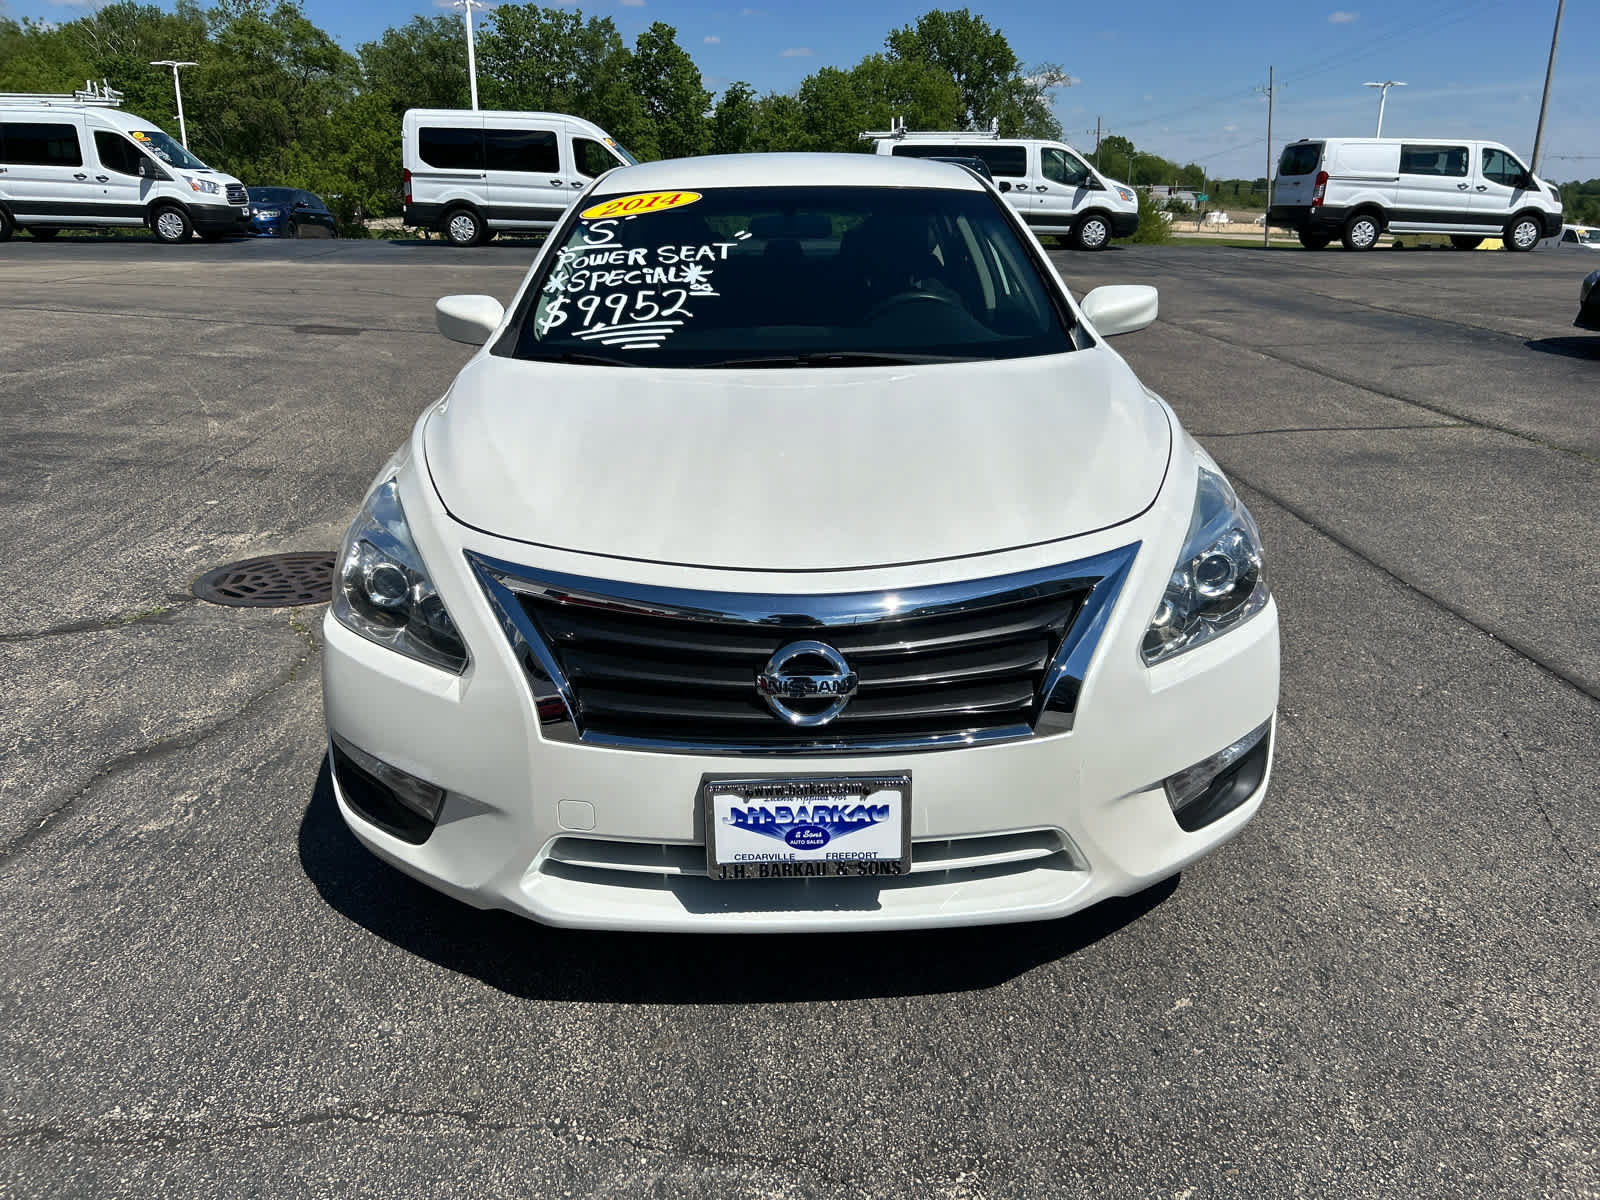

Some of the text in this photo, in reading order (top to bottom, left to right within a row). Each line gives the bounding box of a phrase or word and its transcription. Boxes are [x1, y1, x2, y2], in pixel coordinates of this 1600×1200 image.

[600, 193, 683, 217] 2014
[767, 679, 850, 695] NISSAN
[734, 852, 796, 861] CEDARVILLE
[825, 851, 879, 860] FREEPORT
[759, 861, 826, 877] BARKAU
[836, 860, 849, 876] &
[858, 859, 901, 876] SONS
